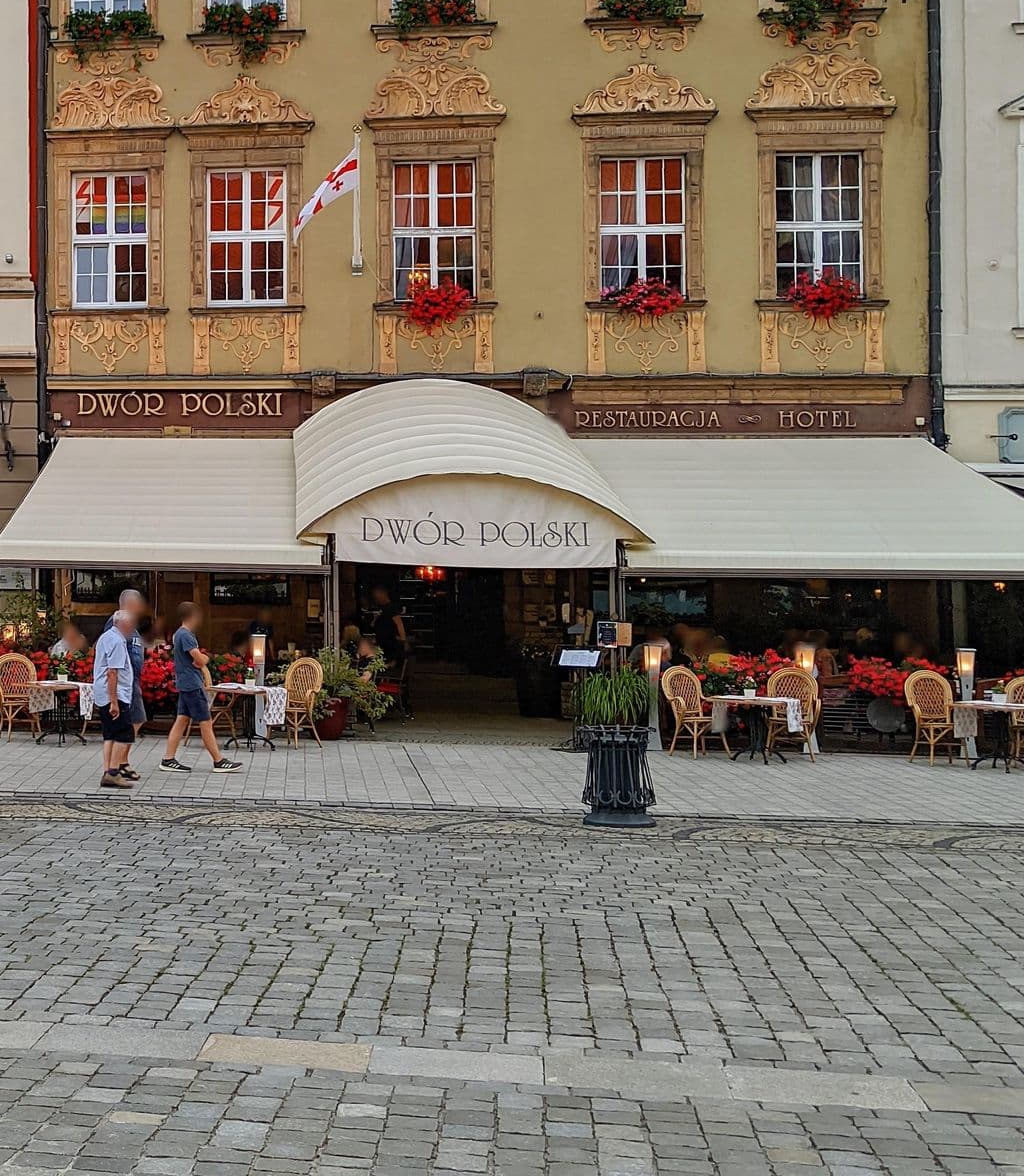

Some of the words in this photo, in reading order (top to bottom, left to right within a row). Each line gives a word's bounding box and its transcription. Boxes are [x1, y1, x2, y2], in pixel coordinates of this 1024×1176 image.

[77, 391, 167, 417] DWÓR
[180, 392, 283, 417] POLSKI
[575, 409, 721, 429] RESTAURACJA
[779, 410, 857, 429] HOTEL
[361, 511, 465, 546] DWÓR
[478, 521, 590, 548] POLSKI
